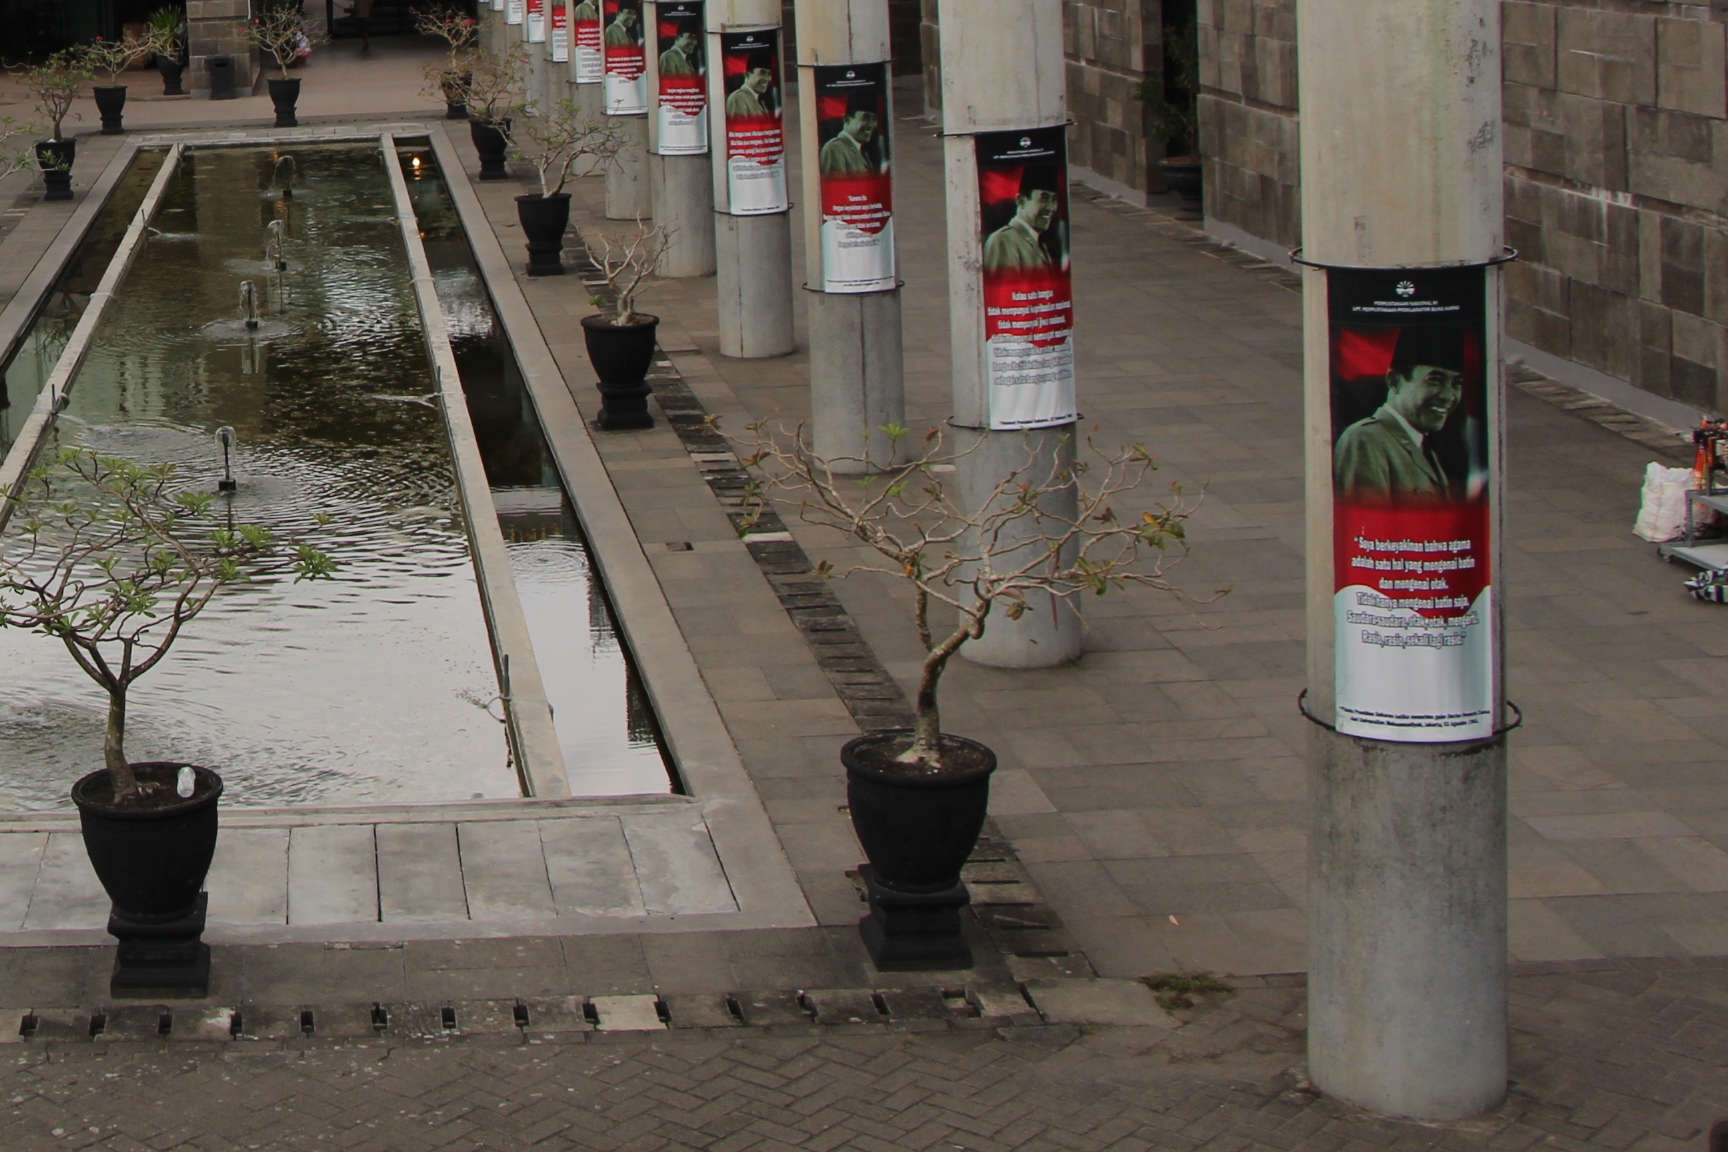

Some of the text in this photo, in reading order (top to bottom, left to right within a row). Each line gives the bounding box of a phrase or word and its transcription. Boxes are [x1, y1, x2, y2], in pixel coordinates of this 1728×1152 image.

[1375, 538, 1423, 554] berkeyakinan
[1424, 539, 1448, 553] bahwa
[1448, 539, 1471, 554] agama
[1351, 555, 1475, 574] adalah satu hal yang mengenai batin
[1378, 577, 1449, 592] dan mengenai otak.
[1356, 591, 1375, 606] Tidak
[1375, 594, 1398, 611] hanya
[1398, 596, 1434, 611] mengenai
[1434, 595, 1453, 608] batin
[1347, 609, 1408, 630] Saudara-saudara,
[1406, 632, 1429, 647] sekali
[1429, 632, 1444, 649] lagi
